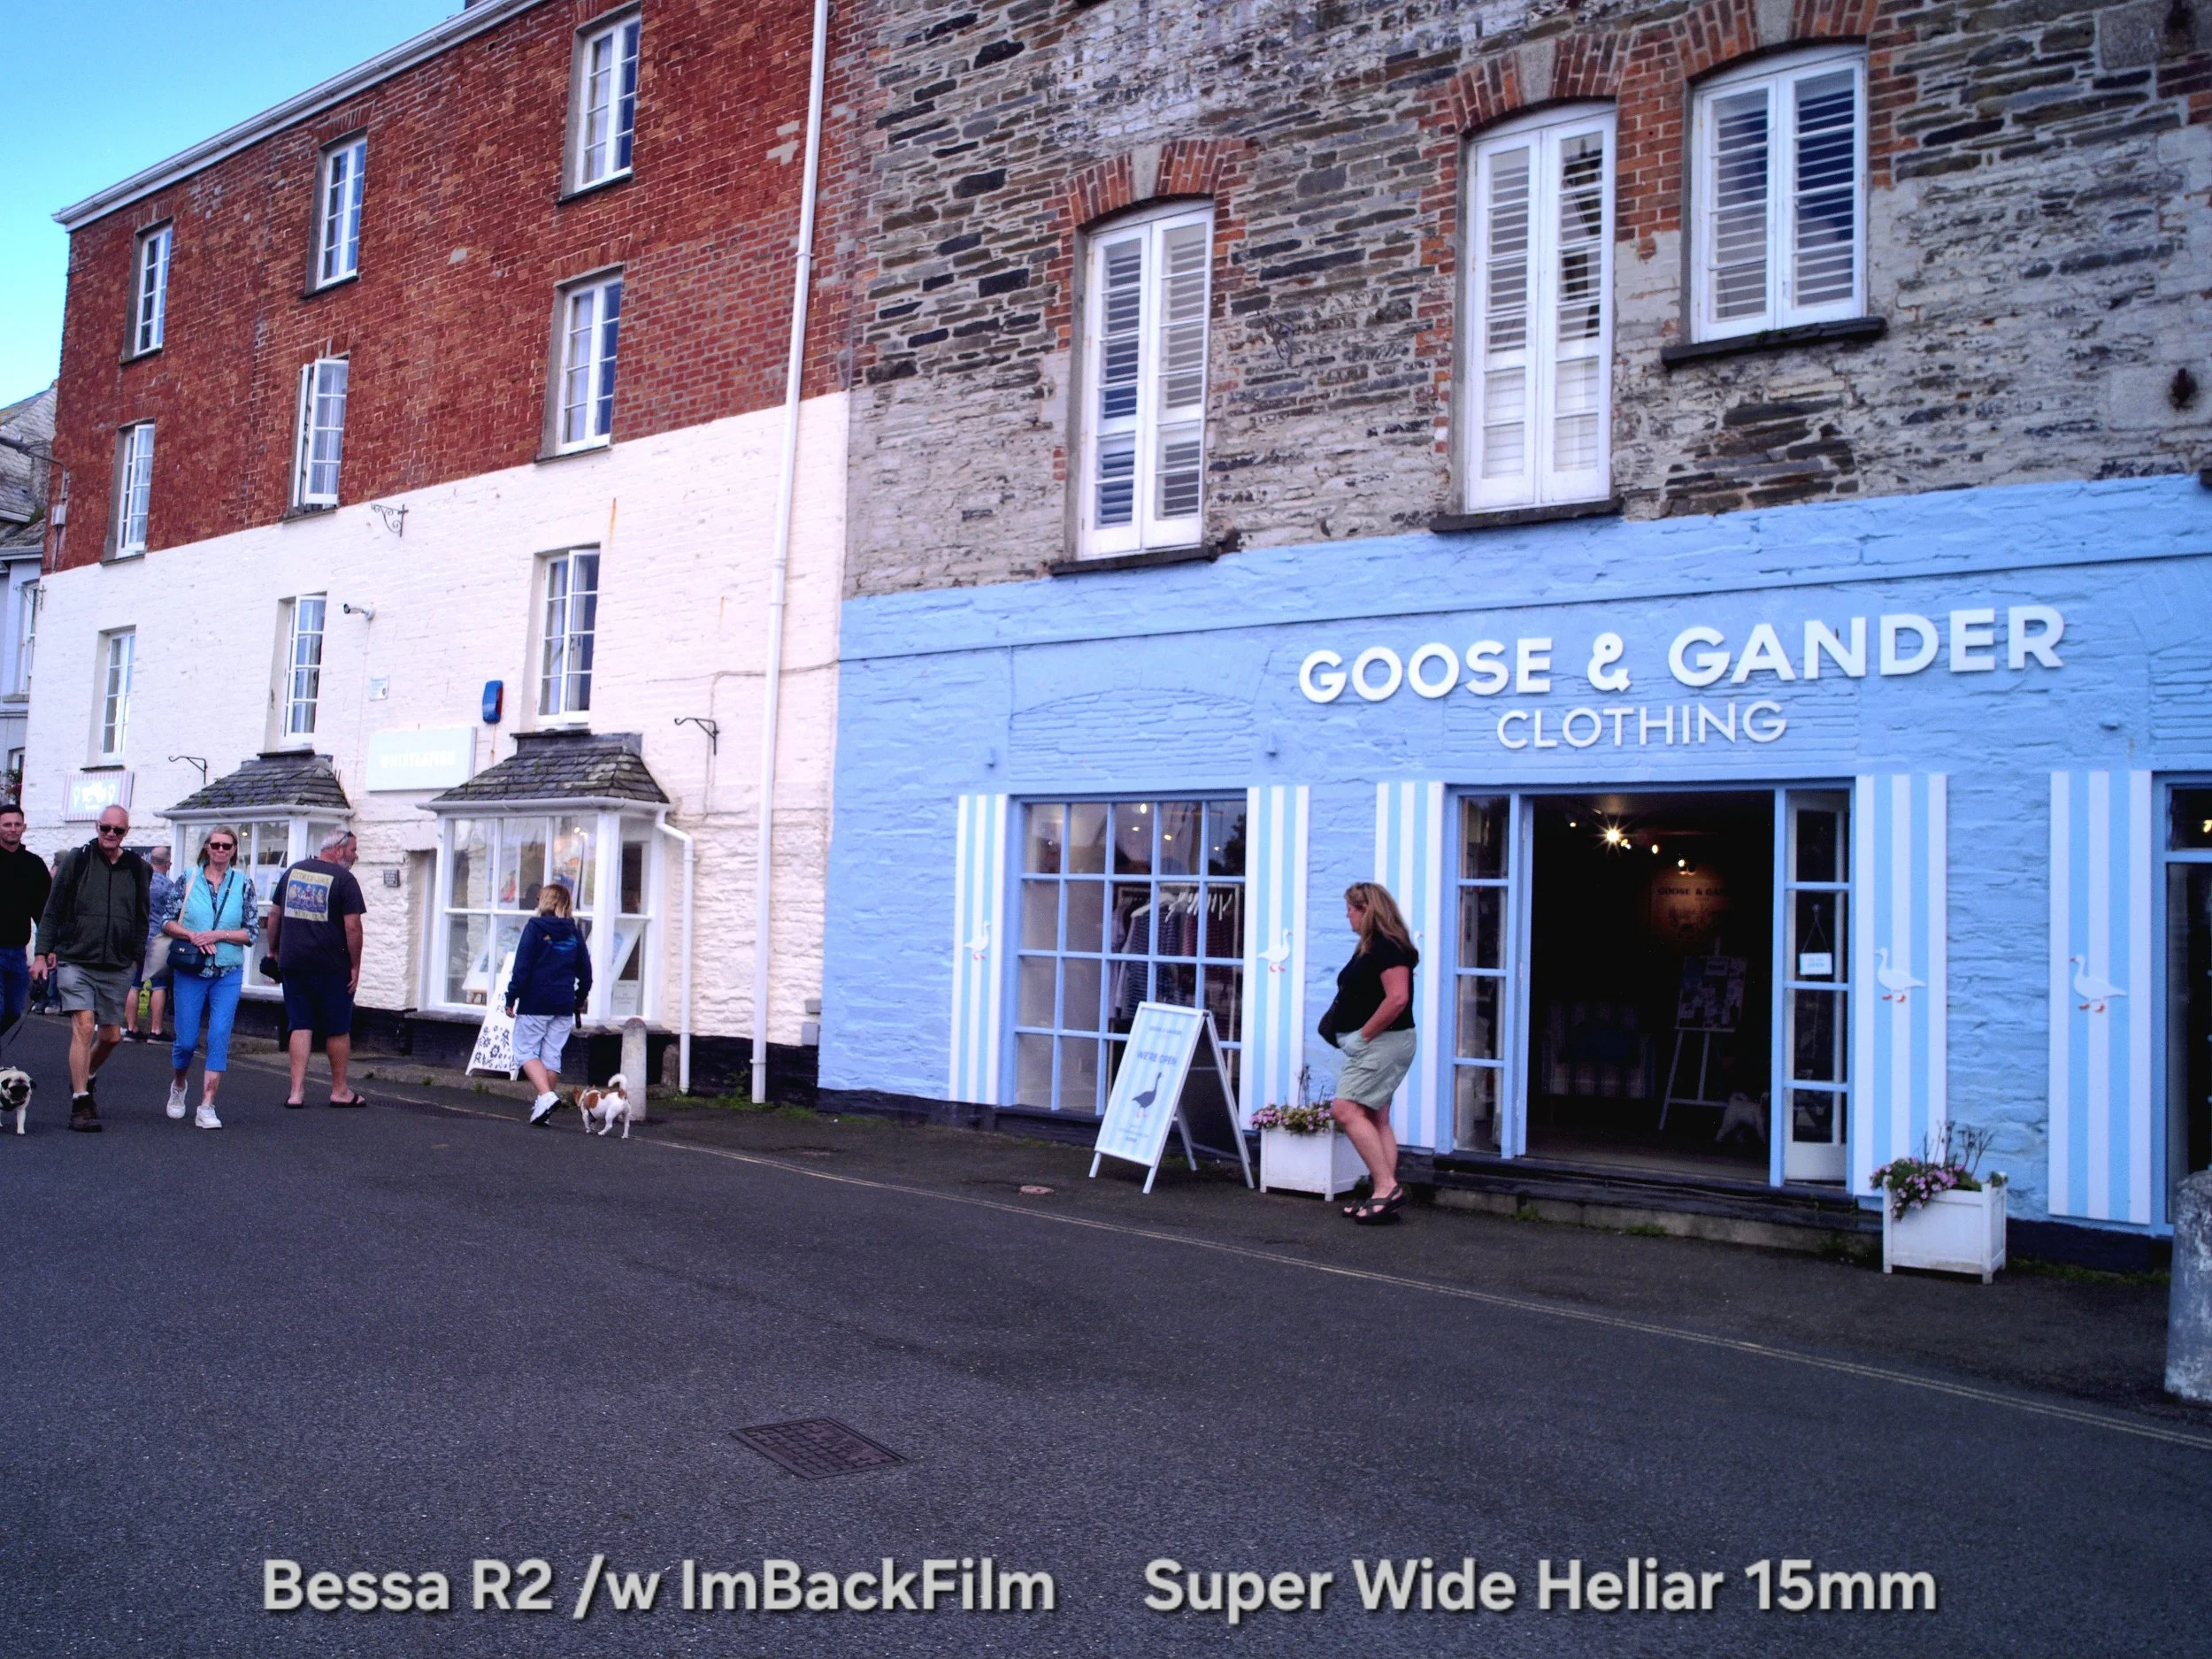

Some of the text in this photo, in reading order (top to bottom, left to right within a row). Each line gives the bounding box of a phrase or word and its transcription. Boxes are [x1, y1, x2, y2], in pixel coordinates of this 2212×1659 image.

[1297, 605, 2065, 703] GOOSE & GANDER
[1496, 700, 1788, 749] CLOTHING
